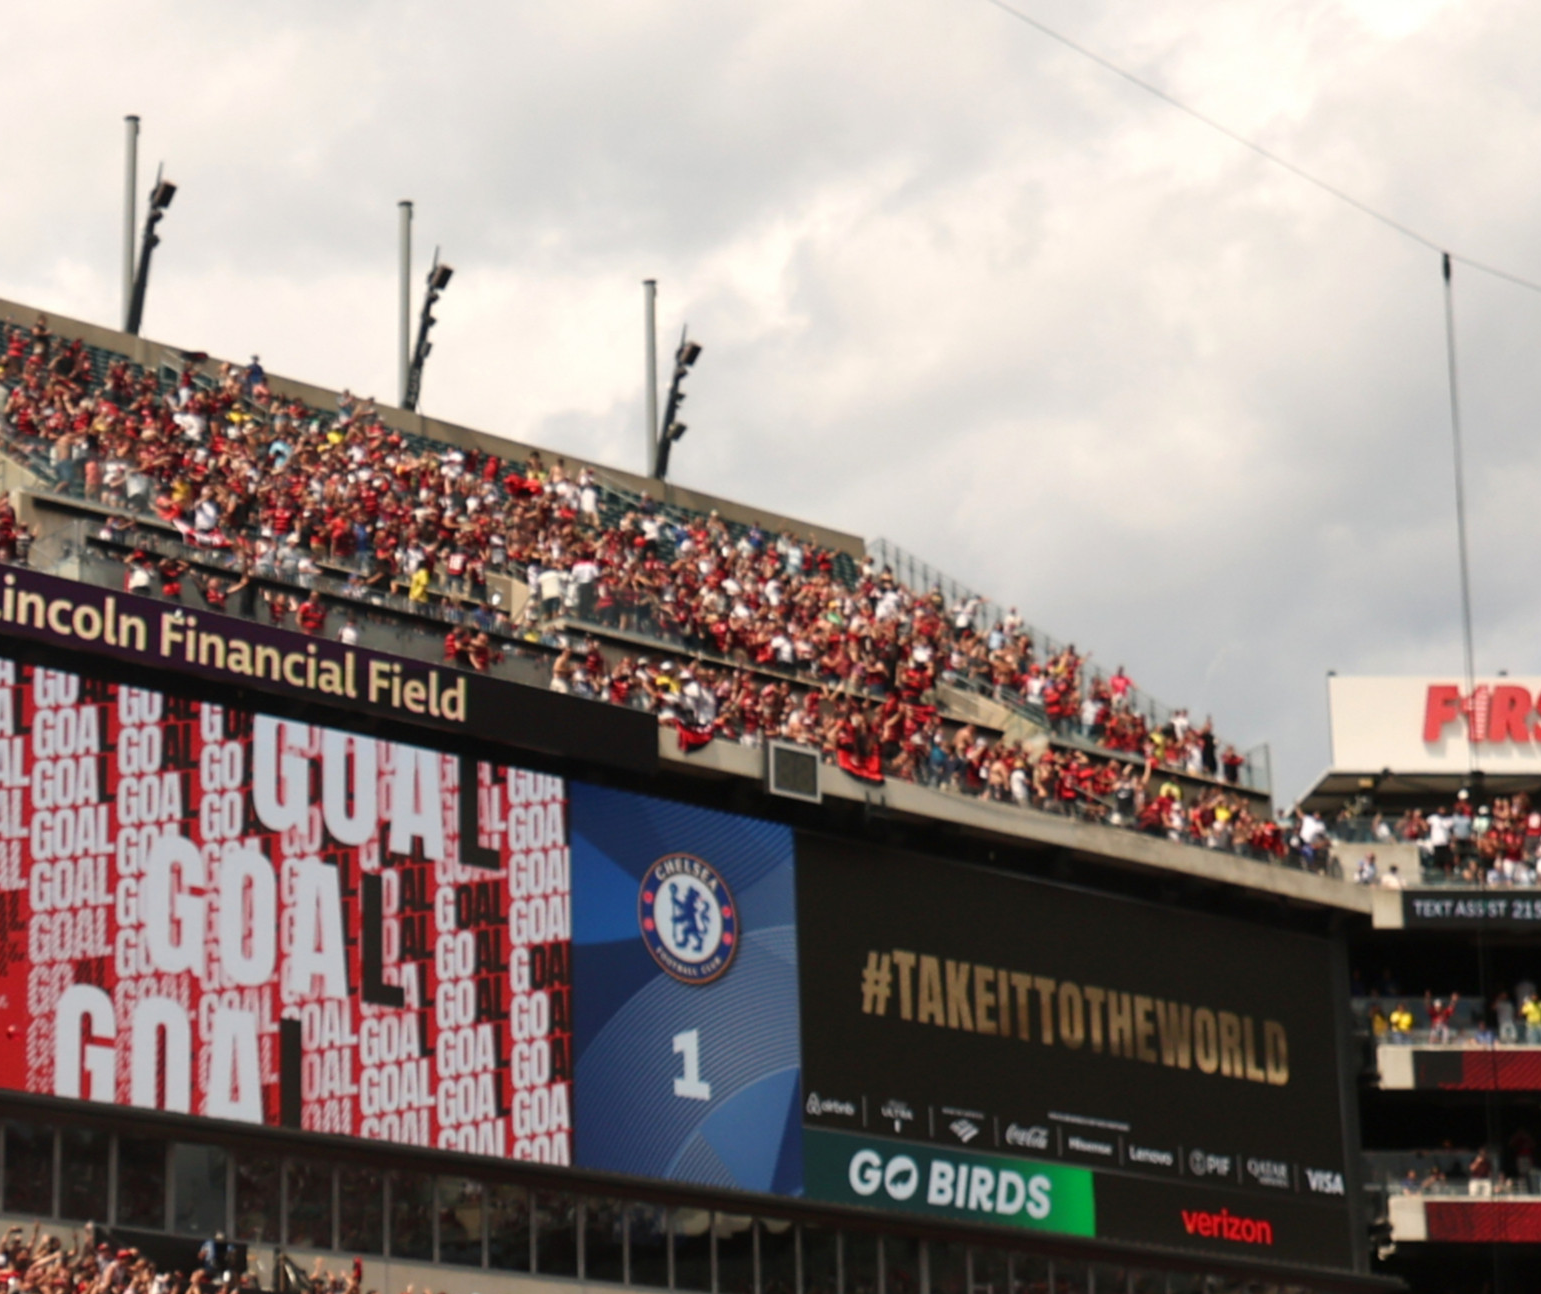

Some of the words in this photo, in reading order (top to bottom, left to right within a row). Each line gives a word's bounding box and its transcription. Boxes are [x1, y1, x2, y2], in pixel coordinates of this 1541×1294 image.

[160, 611, 358, 700] Financial
[368, 658, 467, 723] Field
[253, 712, 500, 872] GOAL
[30, 803, 114, 860] GOAL
[509, 801, 567, 854] GOA
[28, 854, 113, 912] GOAL
[655, 857, 719, 892] CHELSEA
[27, 905, 112, 965] GOAL
[145, 836, 405, 1009] GOAL
[1413, 900, 1453, 918] TEXT
[1455, 899, 1507, 918] ASSST
[656, 946, 699, 977] FOOTBALL
[862, 948, 1289, 1087] #TAKEITTOTHEWORLD
[360, 1056, 437, 1116] GOAL
[672, 1027, 712, 1101] 1
[512, 1081, 570, 1139] GOA
[848, 1148, 919, 1201] GO
[927, 1159, 1052, 1220] BIRDS
[1129, 1144, 1173, 1167] Lenovo
[1207, 1154, 1231, 1177] PIF
[1246, 1157, 1289, 1179] QATAR
[1305, 1167, 1345, 1196] VISA
[1181, 1208, 1273, 1245] verizon
